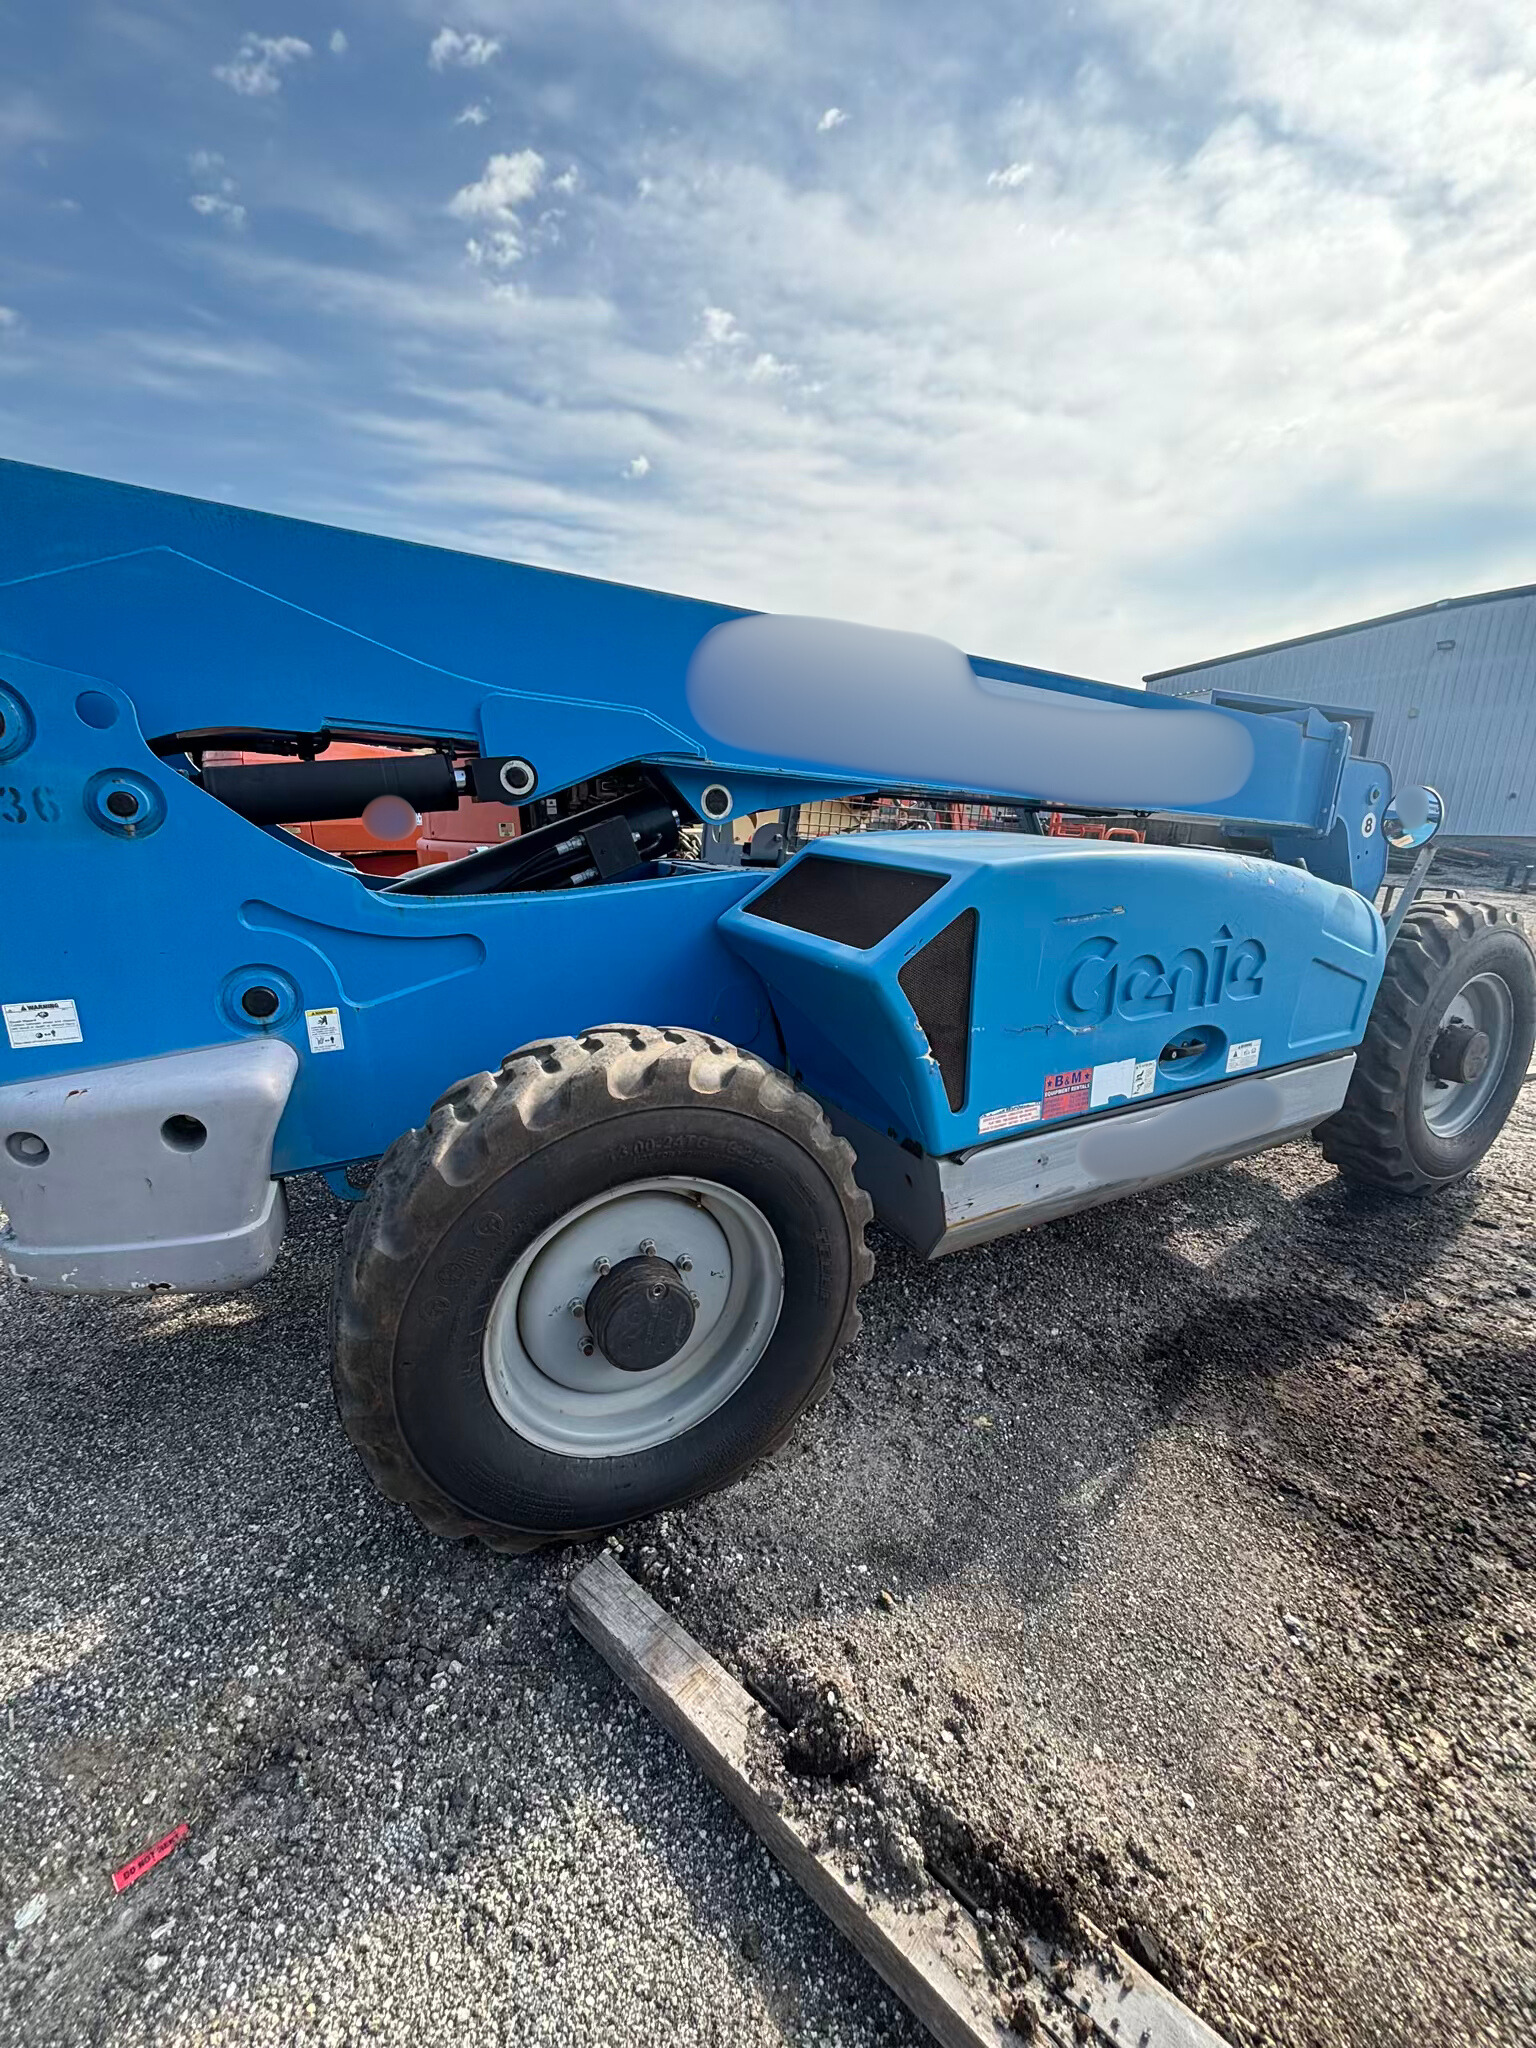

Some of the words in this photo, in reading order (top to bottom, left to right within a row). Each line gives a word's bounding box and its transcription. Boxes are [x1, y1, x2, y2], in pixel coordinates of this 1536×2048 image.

[1364, 817, 1373, 833] 8
[1054, 923, 1267, 1030] Genie
[1044, 1087, 1070, 1098] EQUIPMENT
[1070, 1083, 1090, 1092] RENTALS
[123, 1866, 136, 1881] DO
[137, 1851, 155, 1869] NOT
